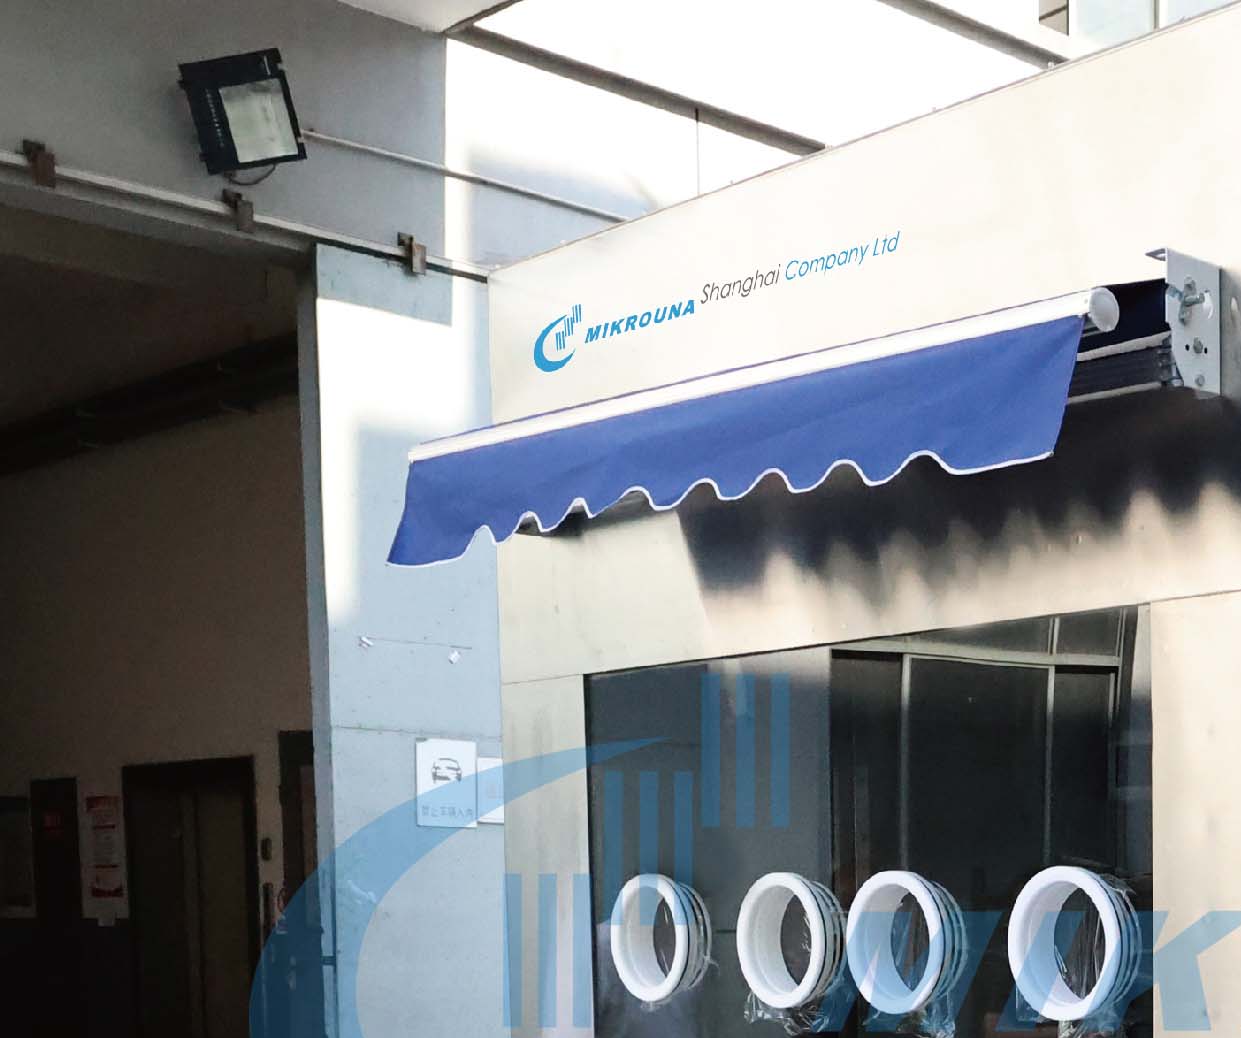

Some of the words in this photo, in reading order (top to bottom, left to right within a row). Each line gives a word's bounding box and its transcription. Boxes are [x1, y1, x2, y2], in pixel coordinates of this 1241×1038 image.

[584, 299, 695, 344] MIKROUNA
[700, 264, 781, 305] Shanghai
[785, 244, 870, 281] Company
[873, 230, 901, 257] Ltd
